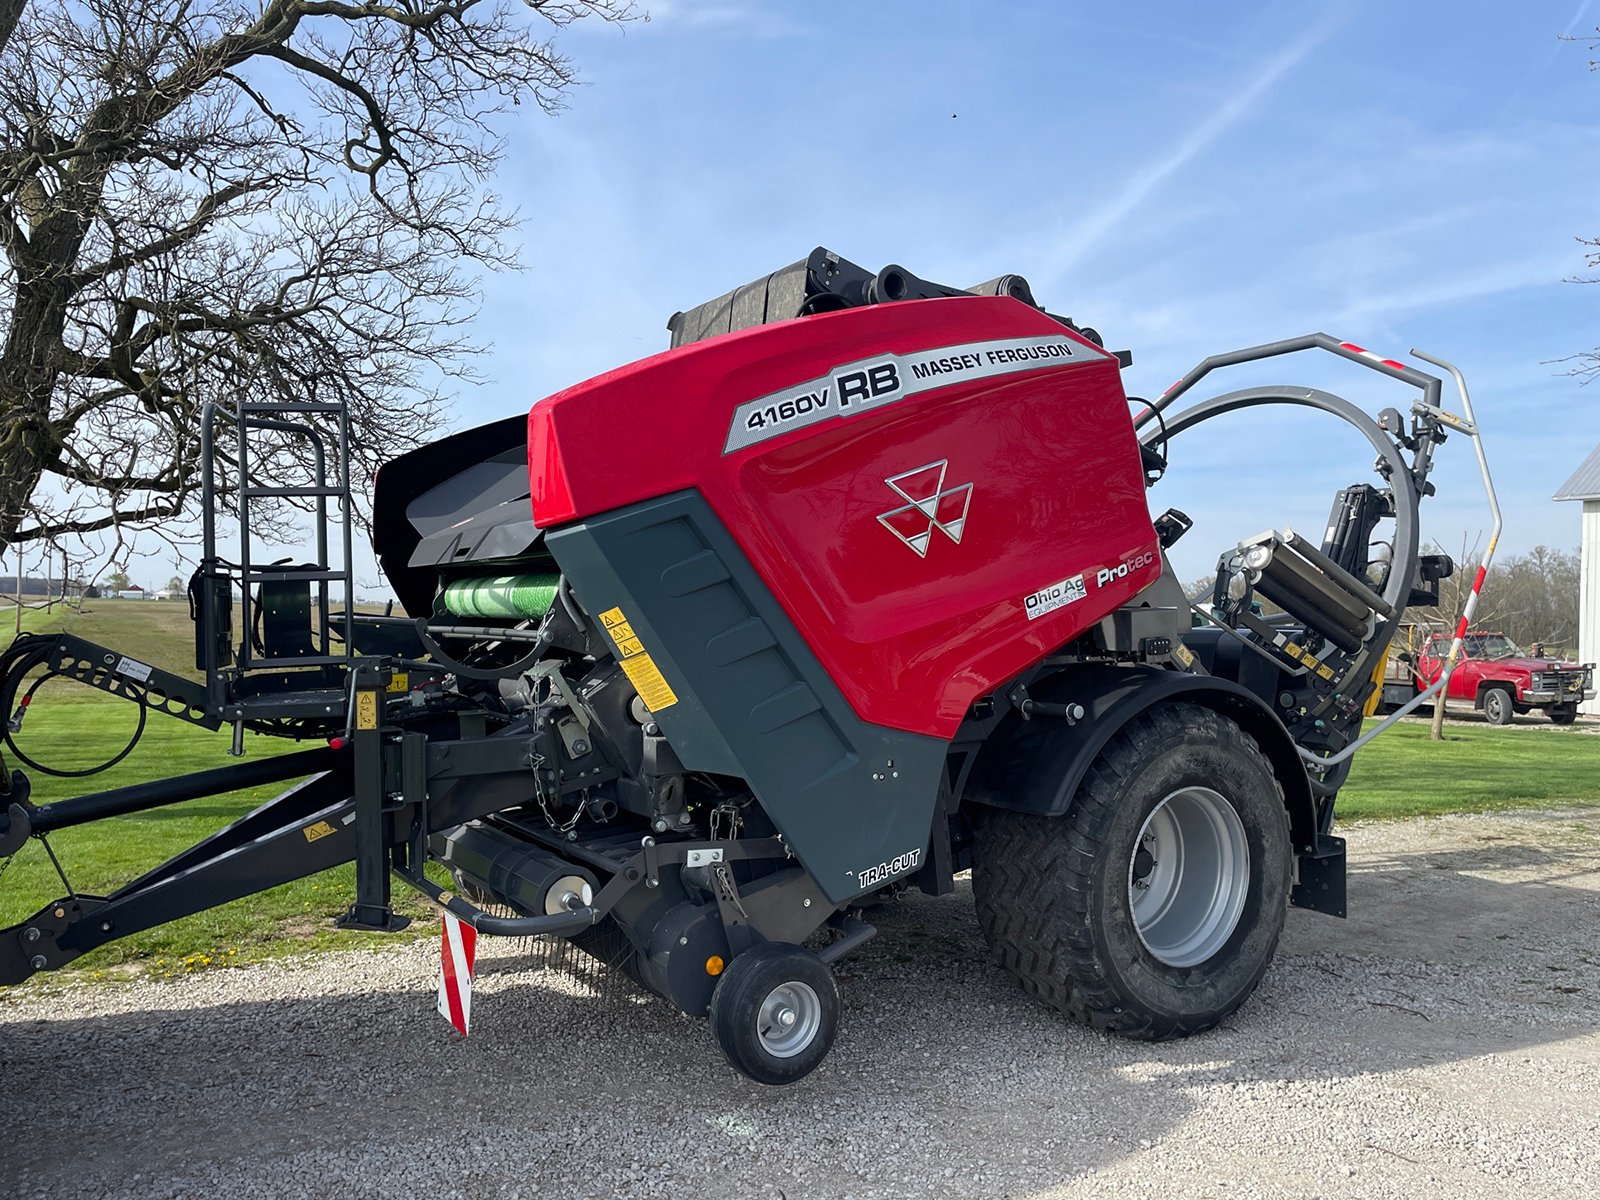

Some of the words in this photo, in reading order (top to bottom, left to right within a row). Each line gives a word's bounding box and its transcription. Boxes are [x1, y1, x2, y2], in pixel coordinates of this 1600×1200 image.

[911, 352, 982, 380] MASSEY
[987, 343, 1073, 366] FERGUSON
[746, 388, 830, 430] 4160V
[835, 362, 901, 408] RB
[1096, 551, 1153, 588] Protec
[1025, 588, 1061, 609] Ohio
[1064, 577, 1085, 594] Ag
[1028, 592, 1077, 619] EQUIPMENT
[858, 847, 921, 889] TRA-CUT
